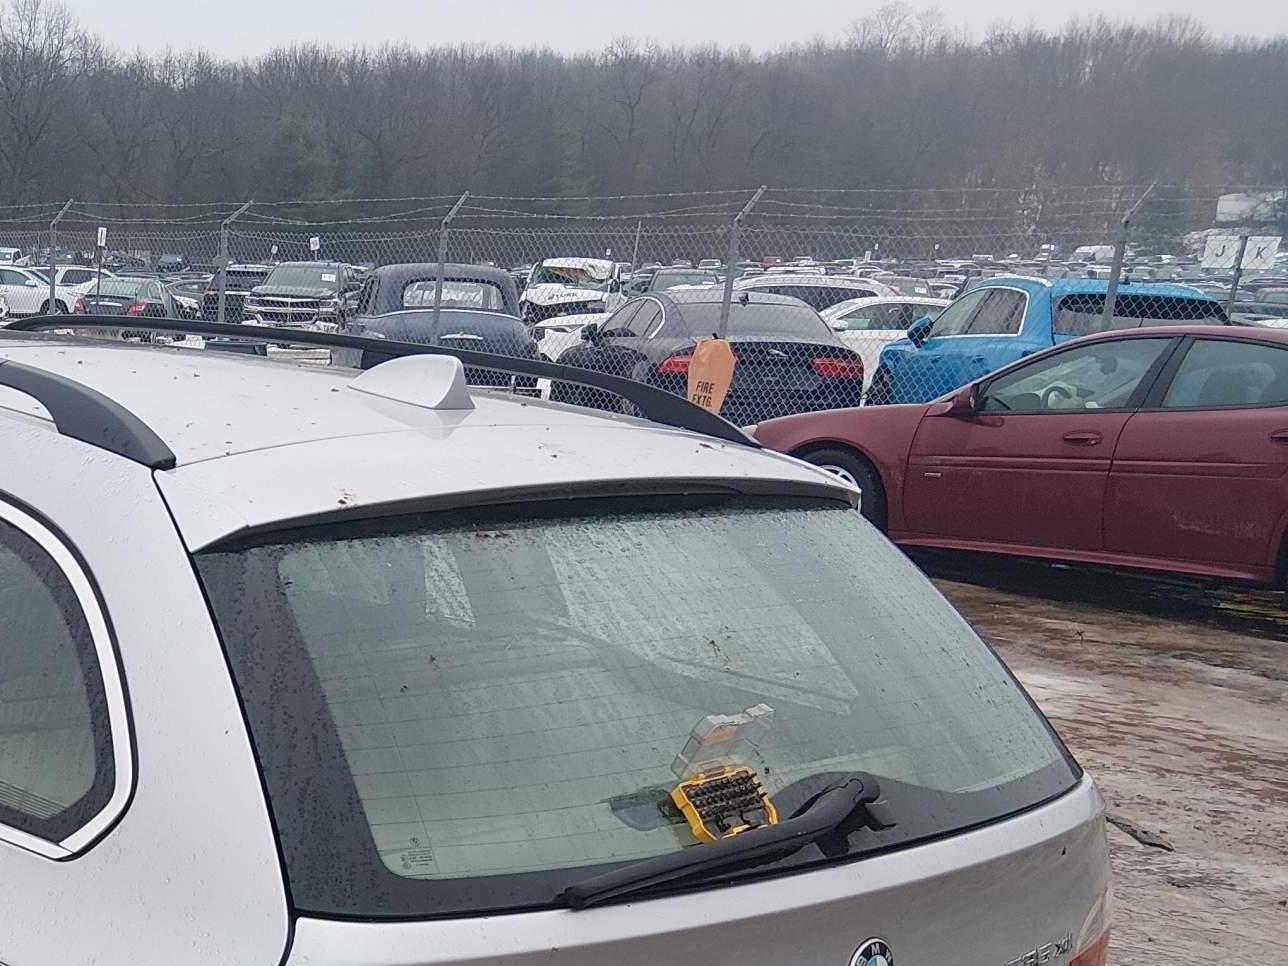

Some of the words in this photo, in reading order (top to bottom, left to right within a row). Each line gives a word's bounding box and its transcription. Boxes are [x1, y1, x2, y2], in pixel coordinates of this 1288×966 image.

[1215, 244, 1226, 258] J
[1255, 246, 1267, 259] K
[695, 380, 715, 394] FIRE
